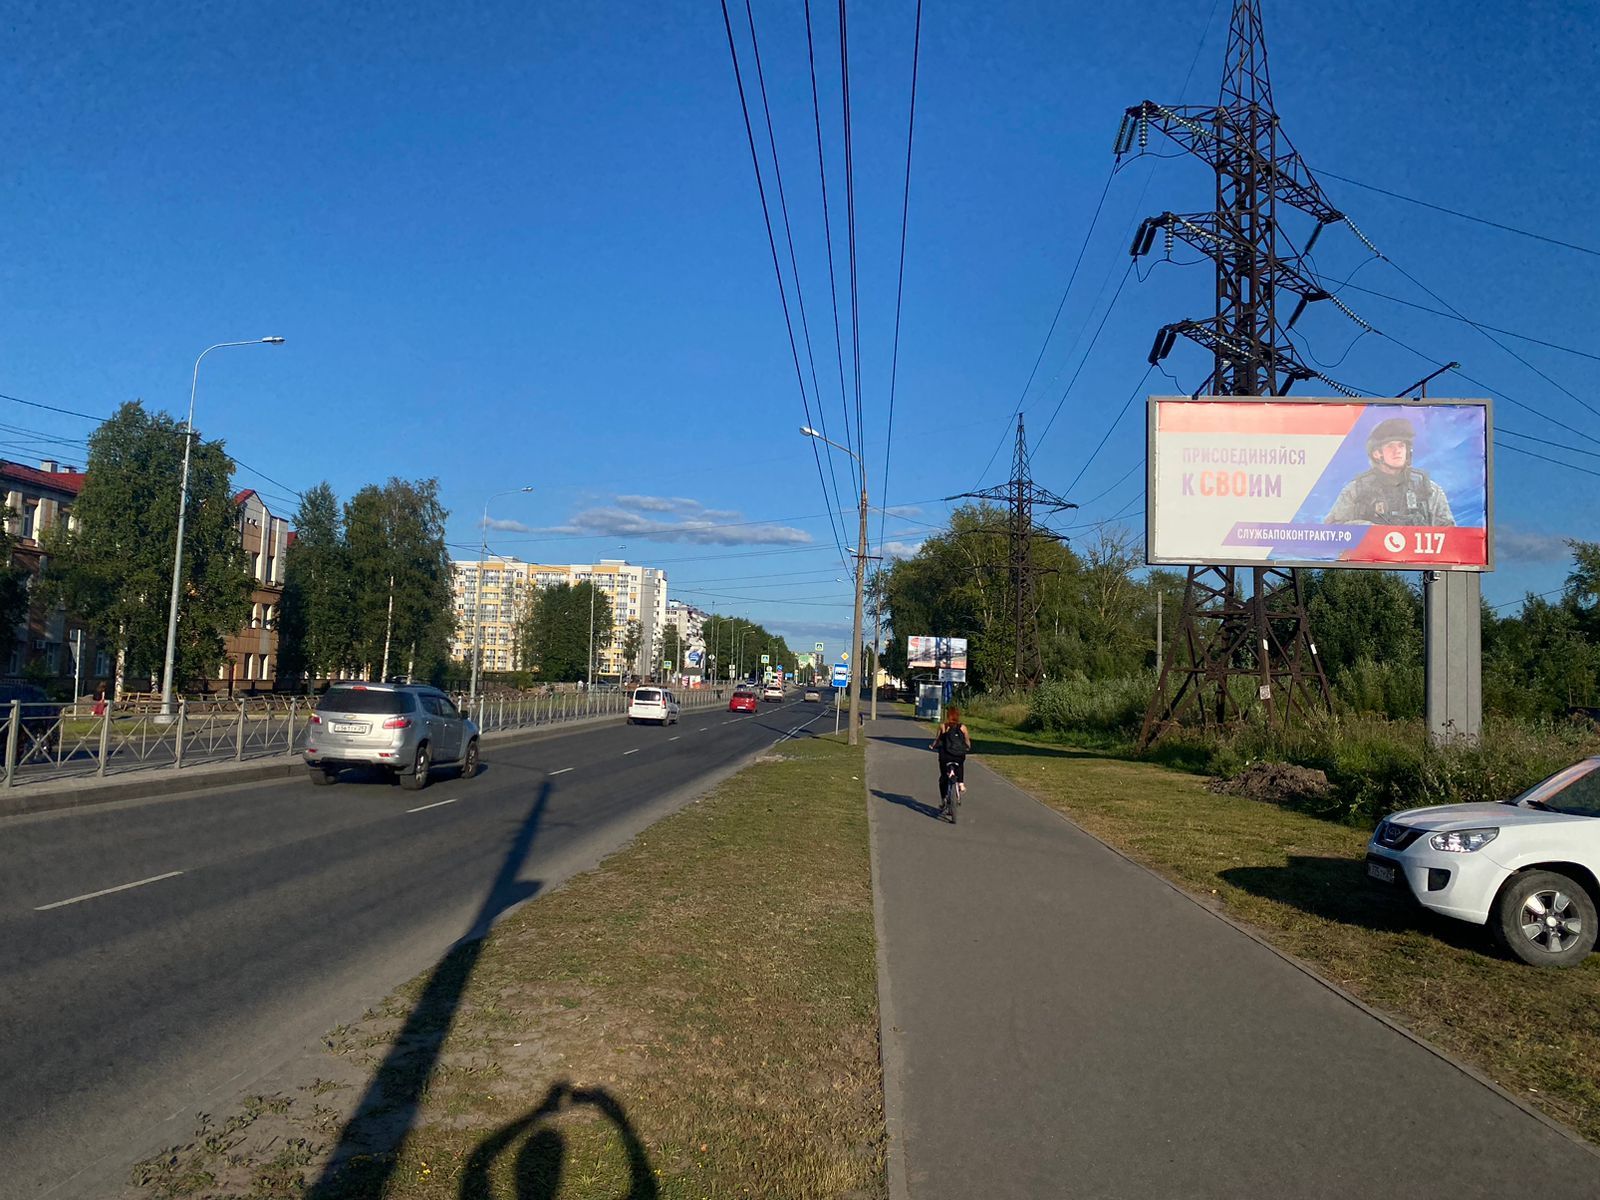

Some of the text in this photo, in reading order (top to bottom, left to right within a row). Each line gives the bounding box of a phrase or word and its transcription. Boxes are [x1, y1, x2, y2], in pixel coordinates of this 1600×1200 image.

[1182, 446, 1306, 466] ПРИСОЕДИНЯЙСЯ
[1182, 469, 1282, 498] К СВОИМ
[1237, 528, 1352, 542] СЛУЖБАПОКОНТРАКТУ.РФ
[1414, 532, 1446, 554] 117
